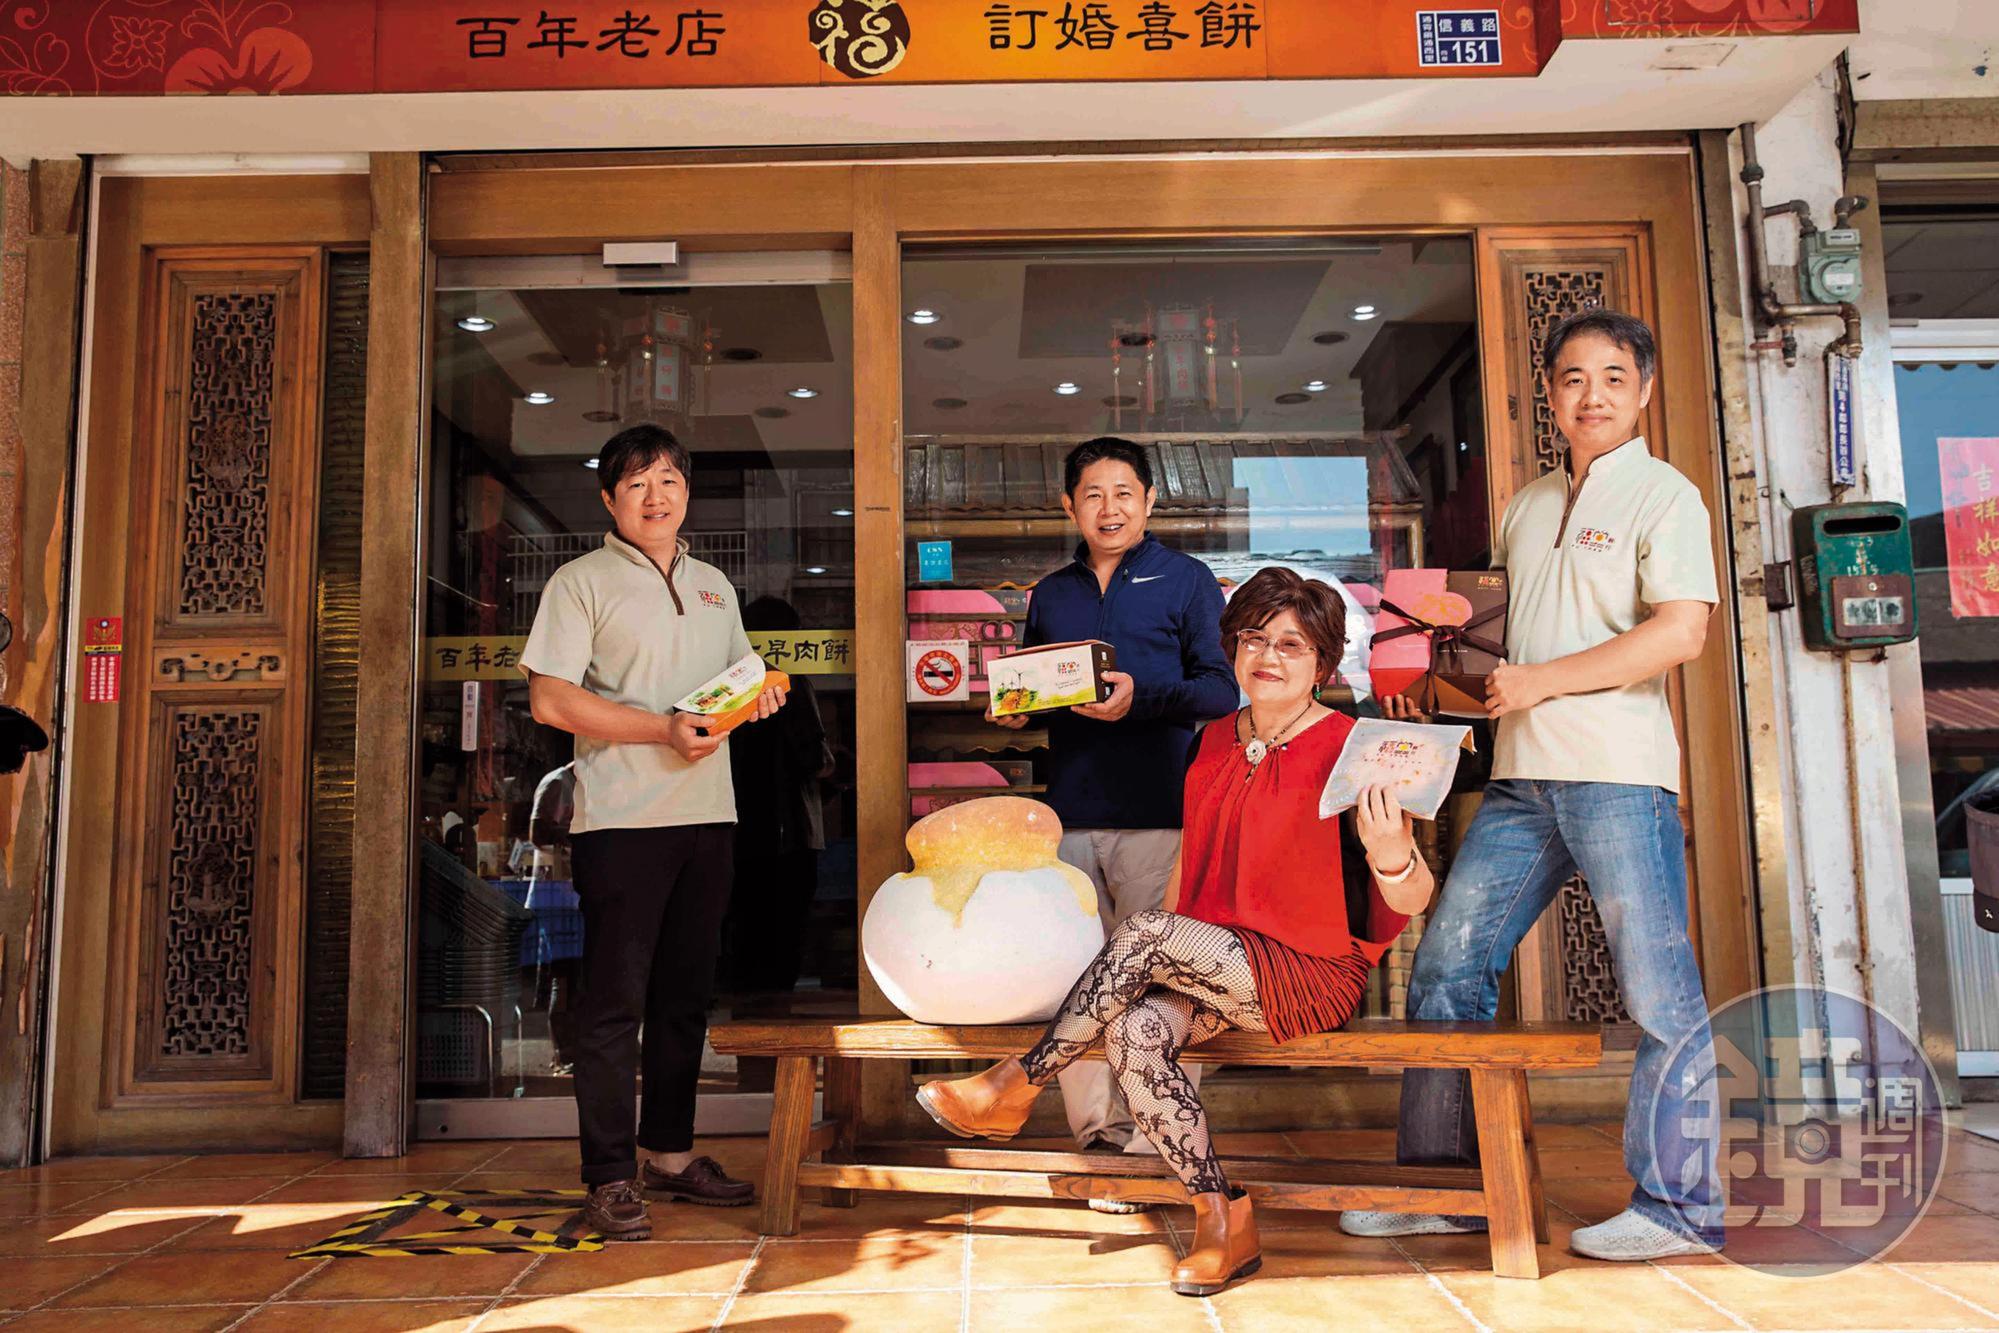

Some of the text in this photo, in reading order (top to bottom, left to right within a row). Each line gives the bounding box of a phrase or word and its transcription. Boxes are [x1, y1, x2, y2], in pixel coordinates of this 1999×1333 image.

[456, 9, 726, 58] 百年老店
[984, 1, 1262, 51] 訂婚喜餅
[1438, 17, 1496, 33] 信義路
[1452, 40, 1489, 63] 151
[435, 638, 850, 672] 百年老 早肉餅
